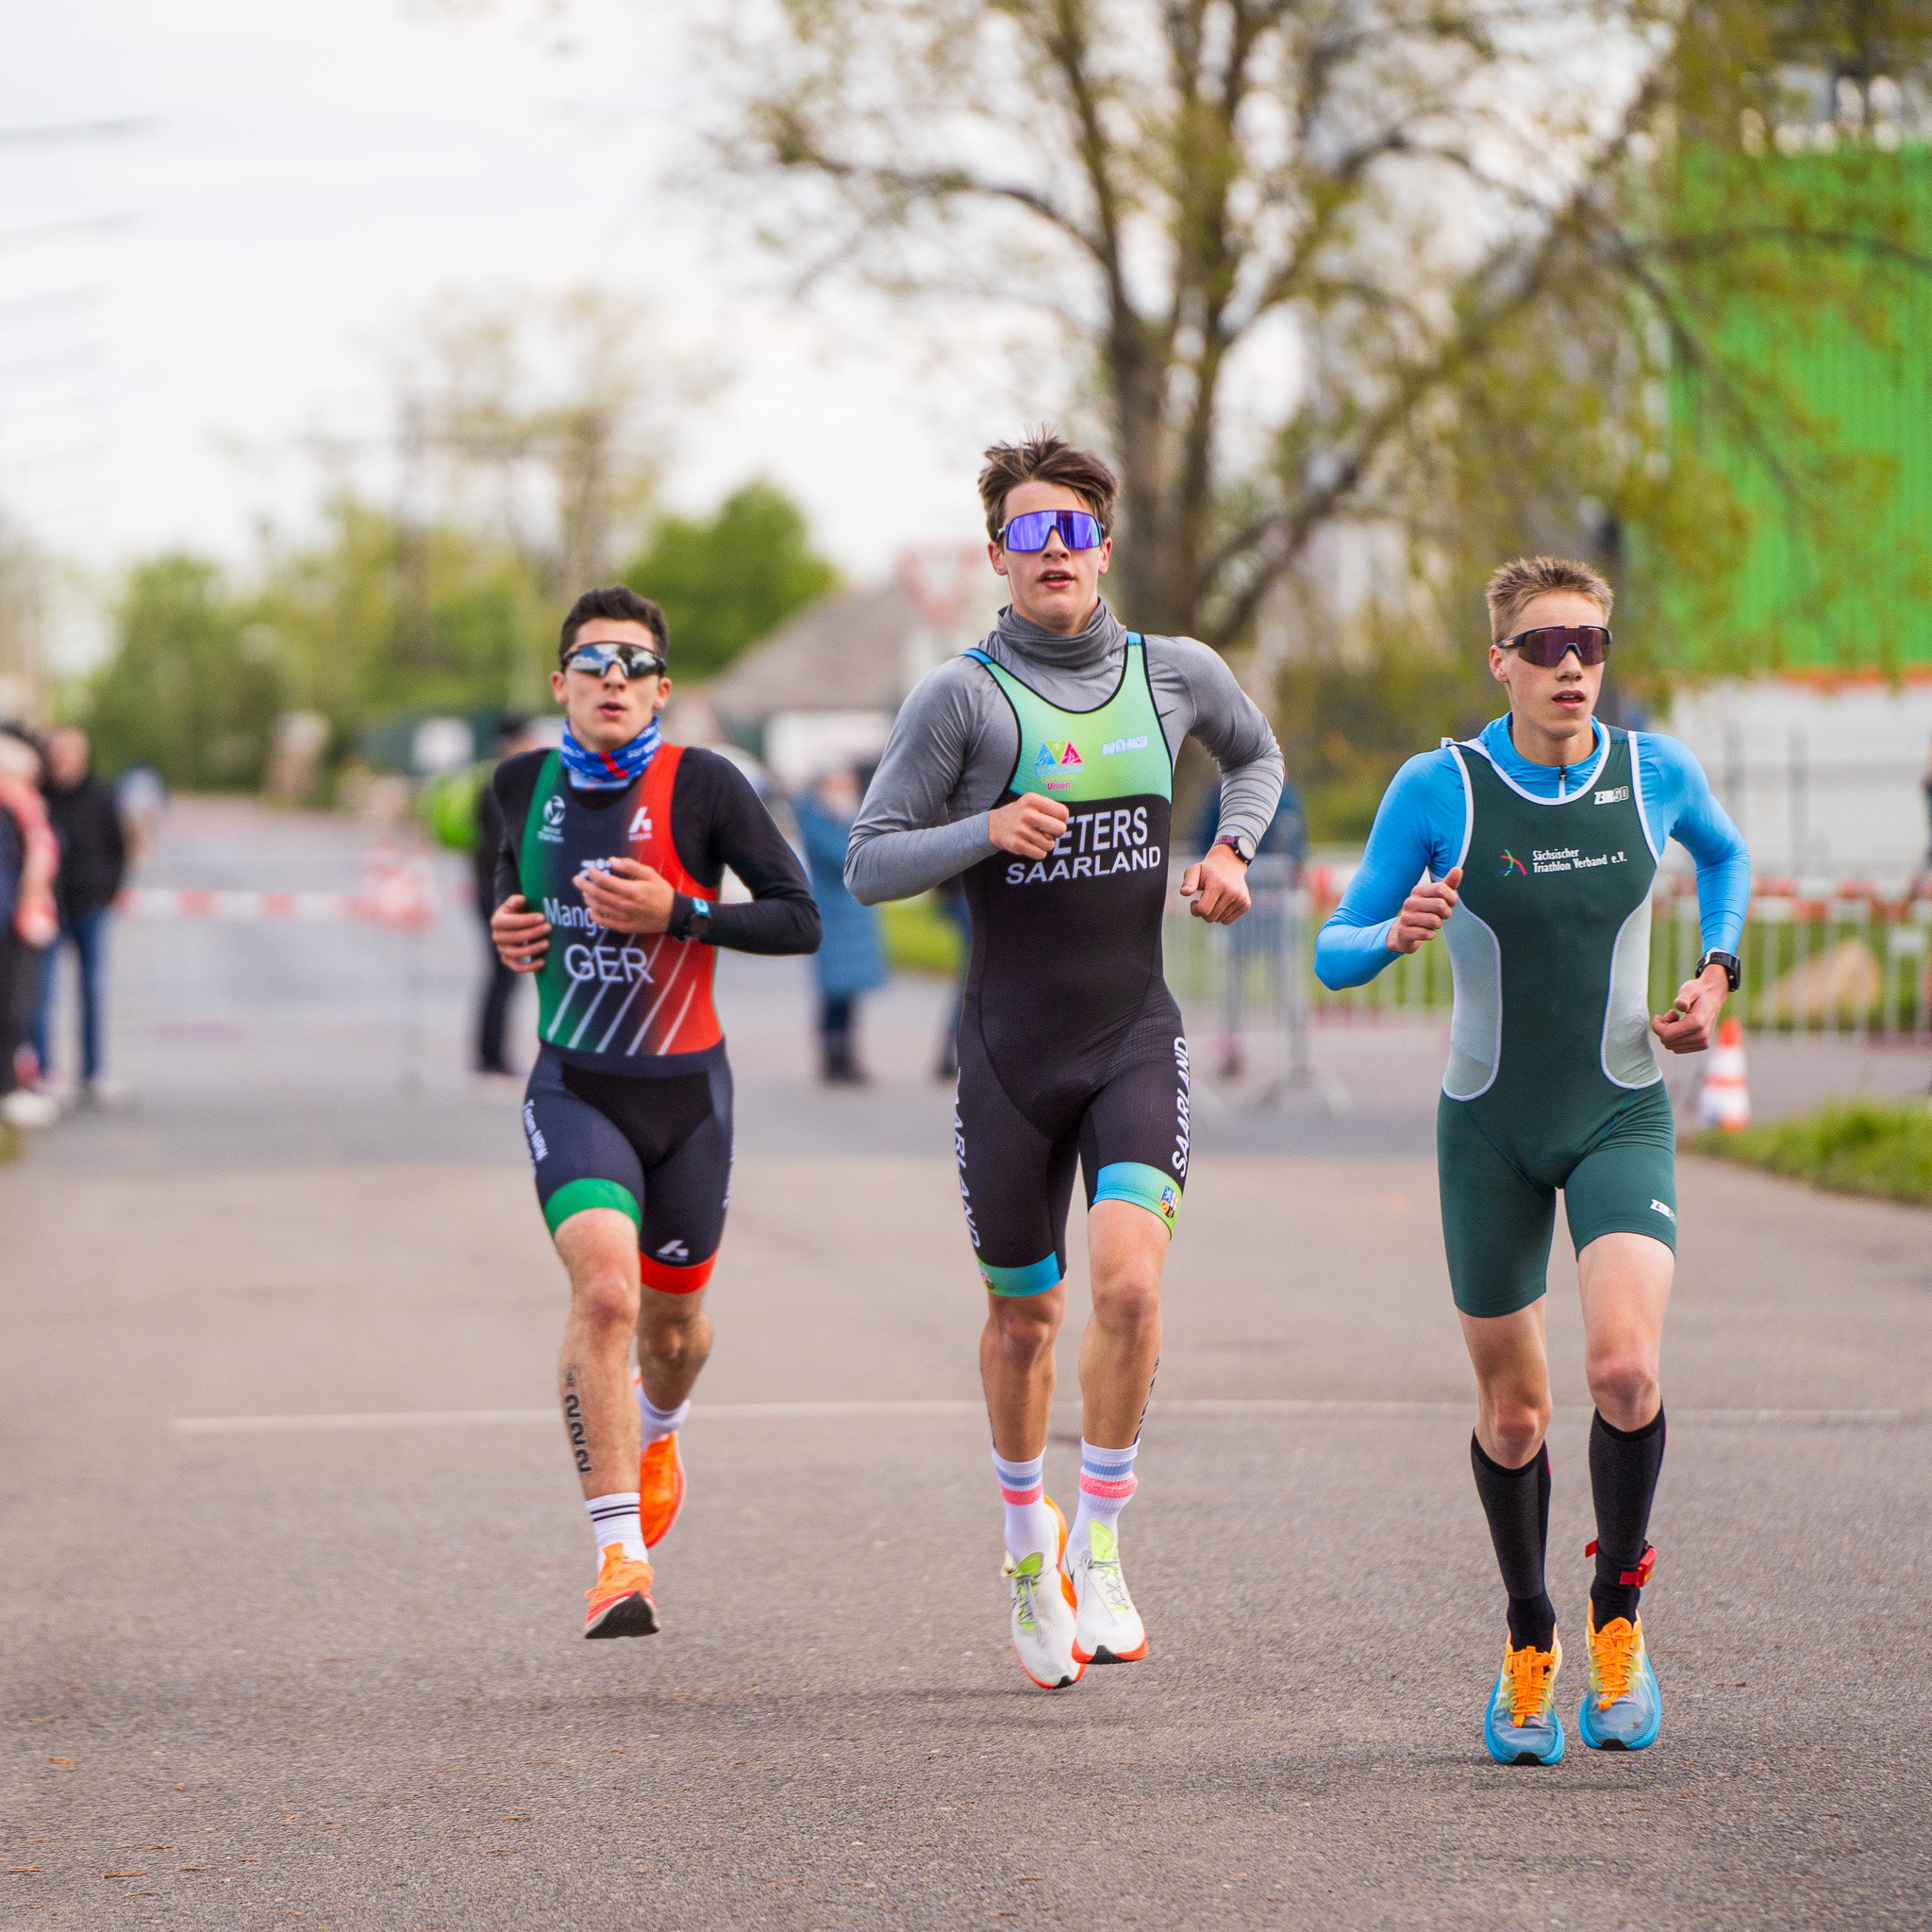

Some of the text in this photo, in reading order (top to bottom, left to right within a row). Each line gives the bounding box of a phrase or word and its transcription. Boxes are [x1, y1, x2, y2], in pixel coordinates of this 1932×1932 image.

[1047, 781, 1071, 791] Union
[1052, 807, 1148, 856] ETERS
[1006, 846, 1161, 885] SAARLAND
[1532, 848, 1579, 861] Sächsischer
[1532, 851, 1628, 874] Triathlon Verband e.V.
[564, 944, 655, 984] GER
[1172, 1036, 1190, 1178] SAARLAND
[530, 1129, 549, 1161] NRW
[565, 1394, 593, 1473] 222
